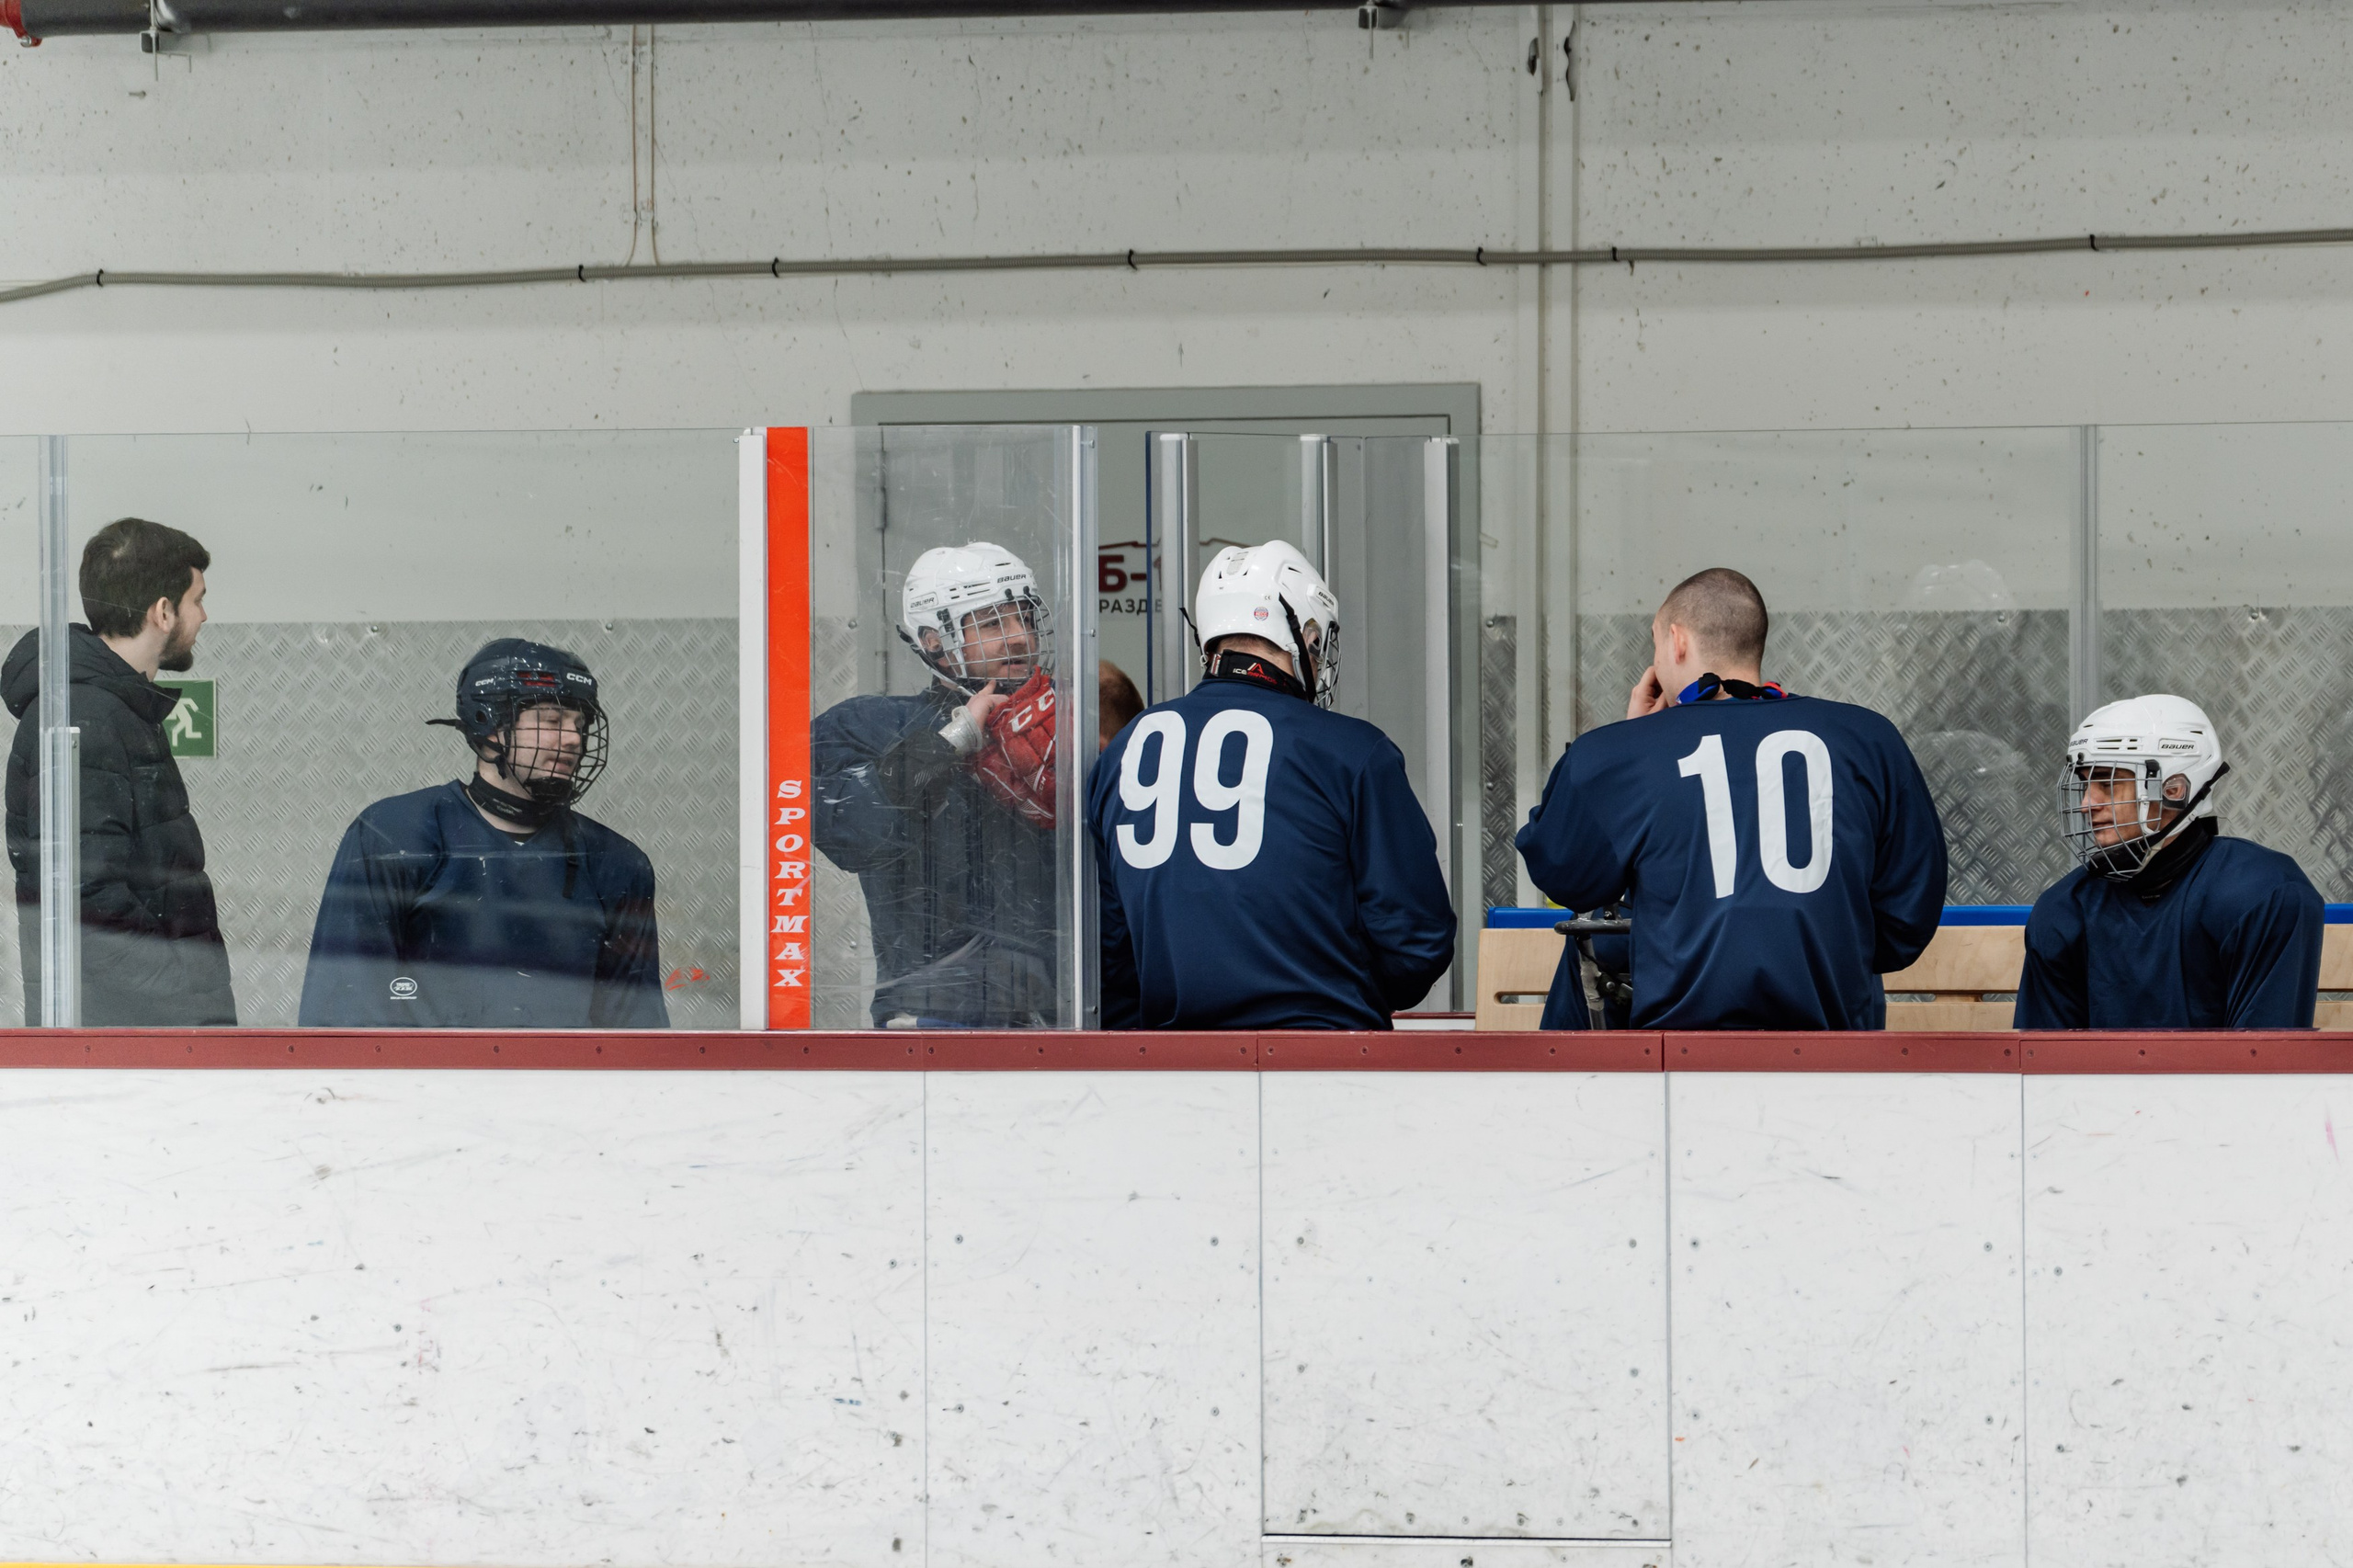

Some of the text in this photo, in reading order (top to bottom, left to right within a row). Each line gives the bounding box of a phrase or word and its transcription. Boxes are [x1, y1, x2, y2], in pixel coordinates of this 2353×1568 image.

[474, 677, 494, 687] CCM
[566, 672, 593, 686] CCM
[1008, 688, 1055, 733] CC
[1116, 709, 1274, 870] 99
[1677, 730, 1834, 899] 10
[770, 779, 809, 987] SPORTMAX
